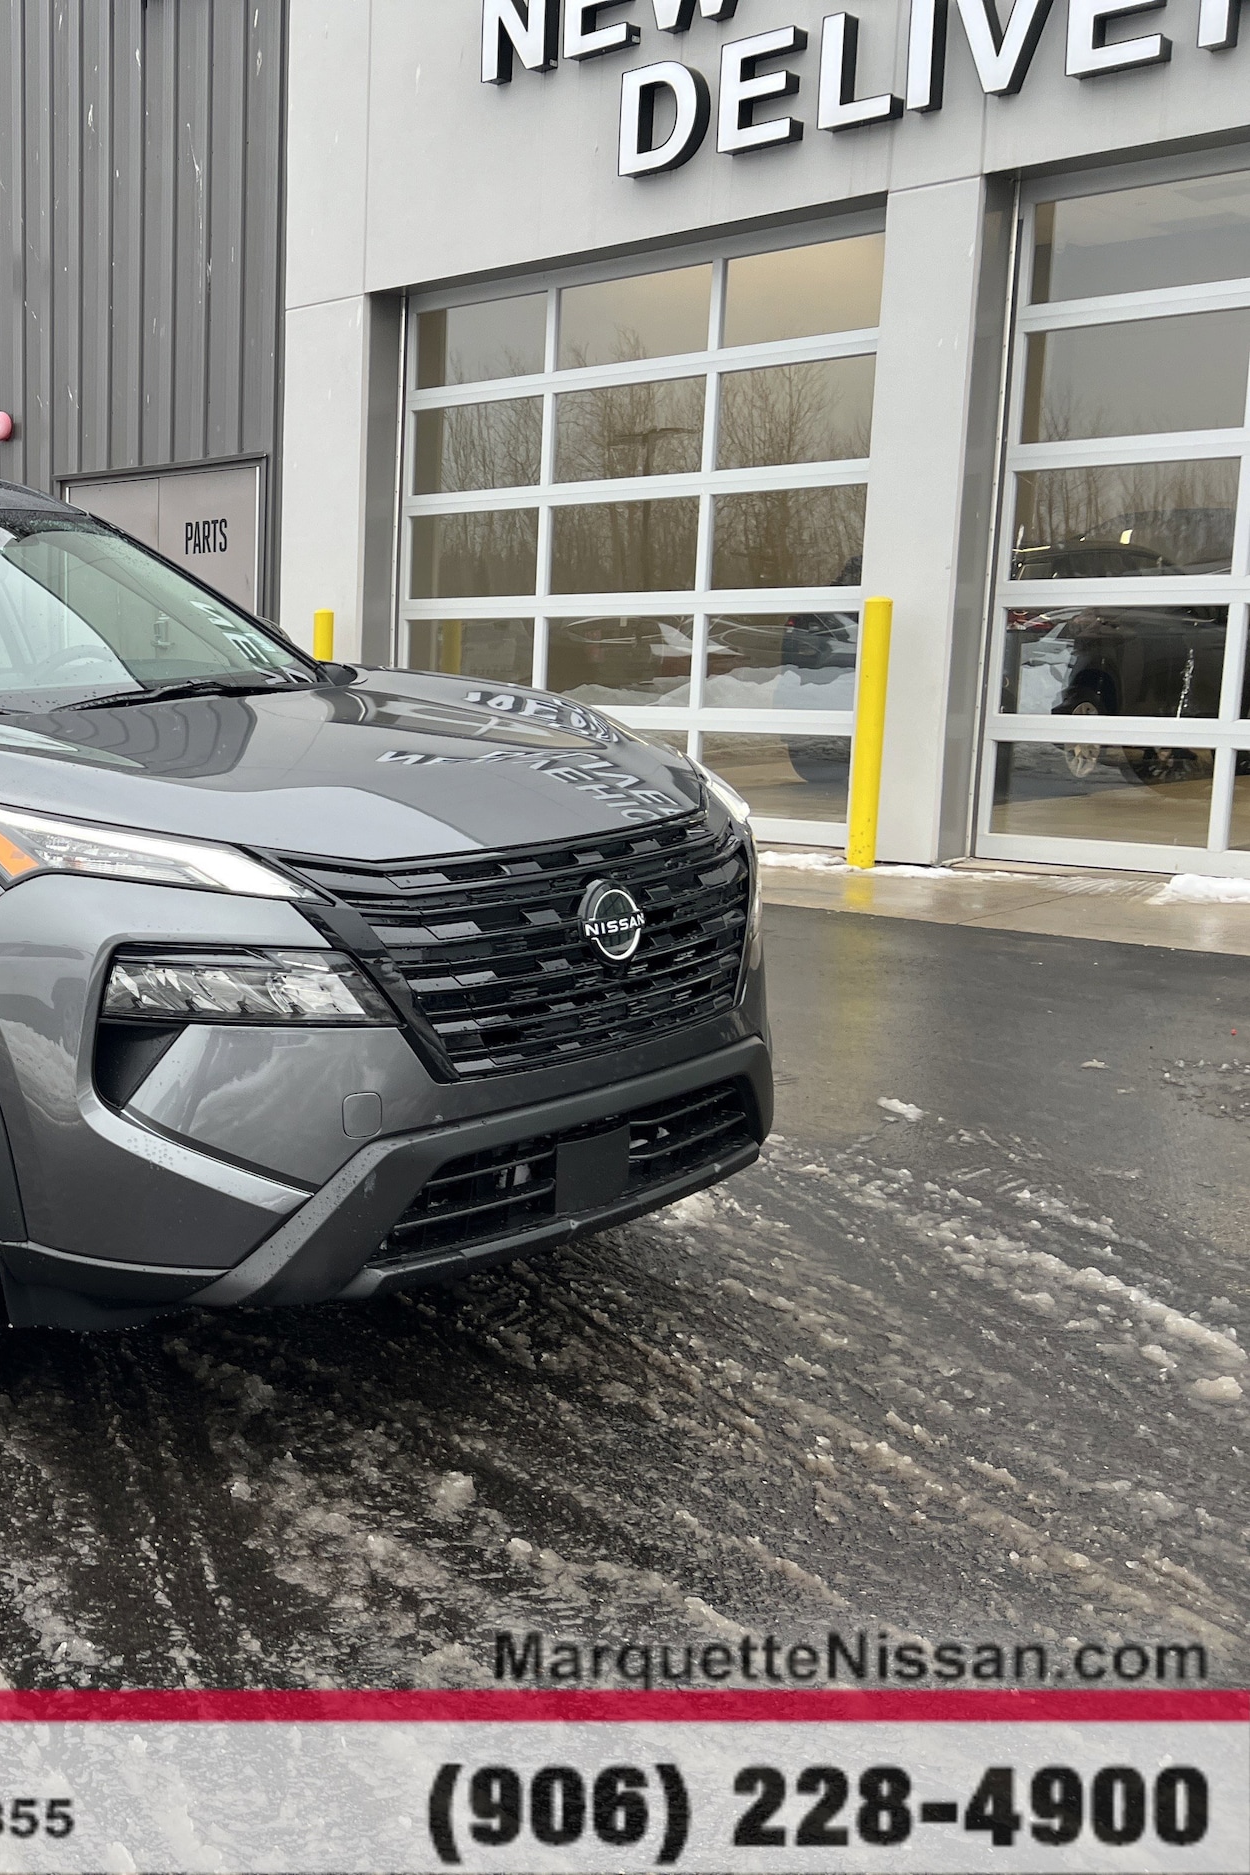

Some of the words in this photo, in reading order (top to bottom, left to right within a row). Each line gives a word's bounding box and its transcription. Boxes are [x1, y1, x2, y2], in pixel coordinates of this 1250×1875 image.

[481, 0, 738, 84] NE
[618, 0, 1250, 178] DELIVE
[185, 518, 227, 555] PARTS
[584, 912, 645, 937] NISSAN
